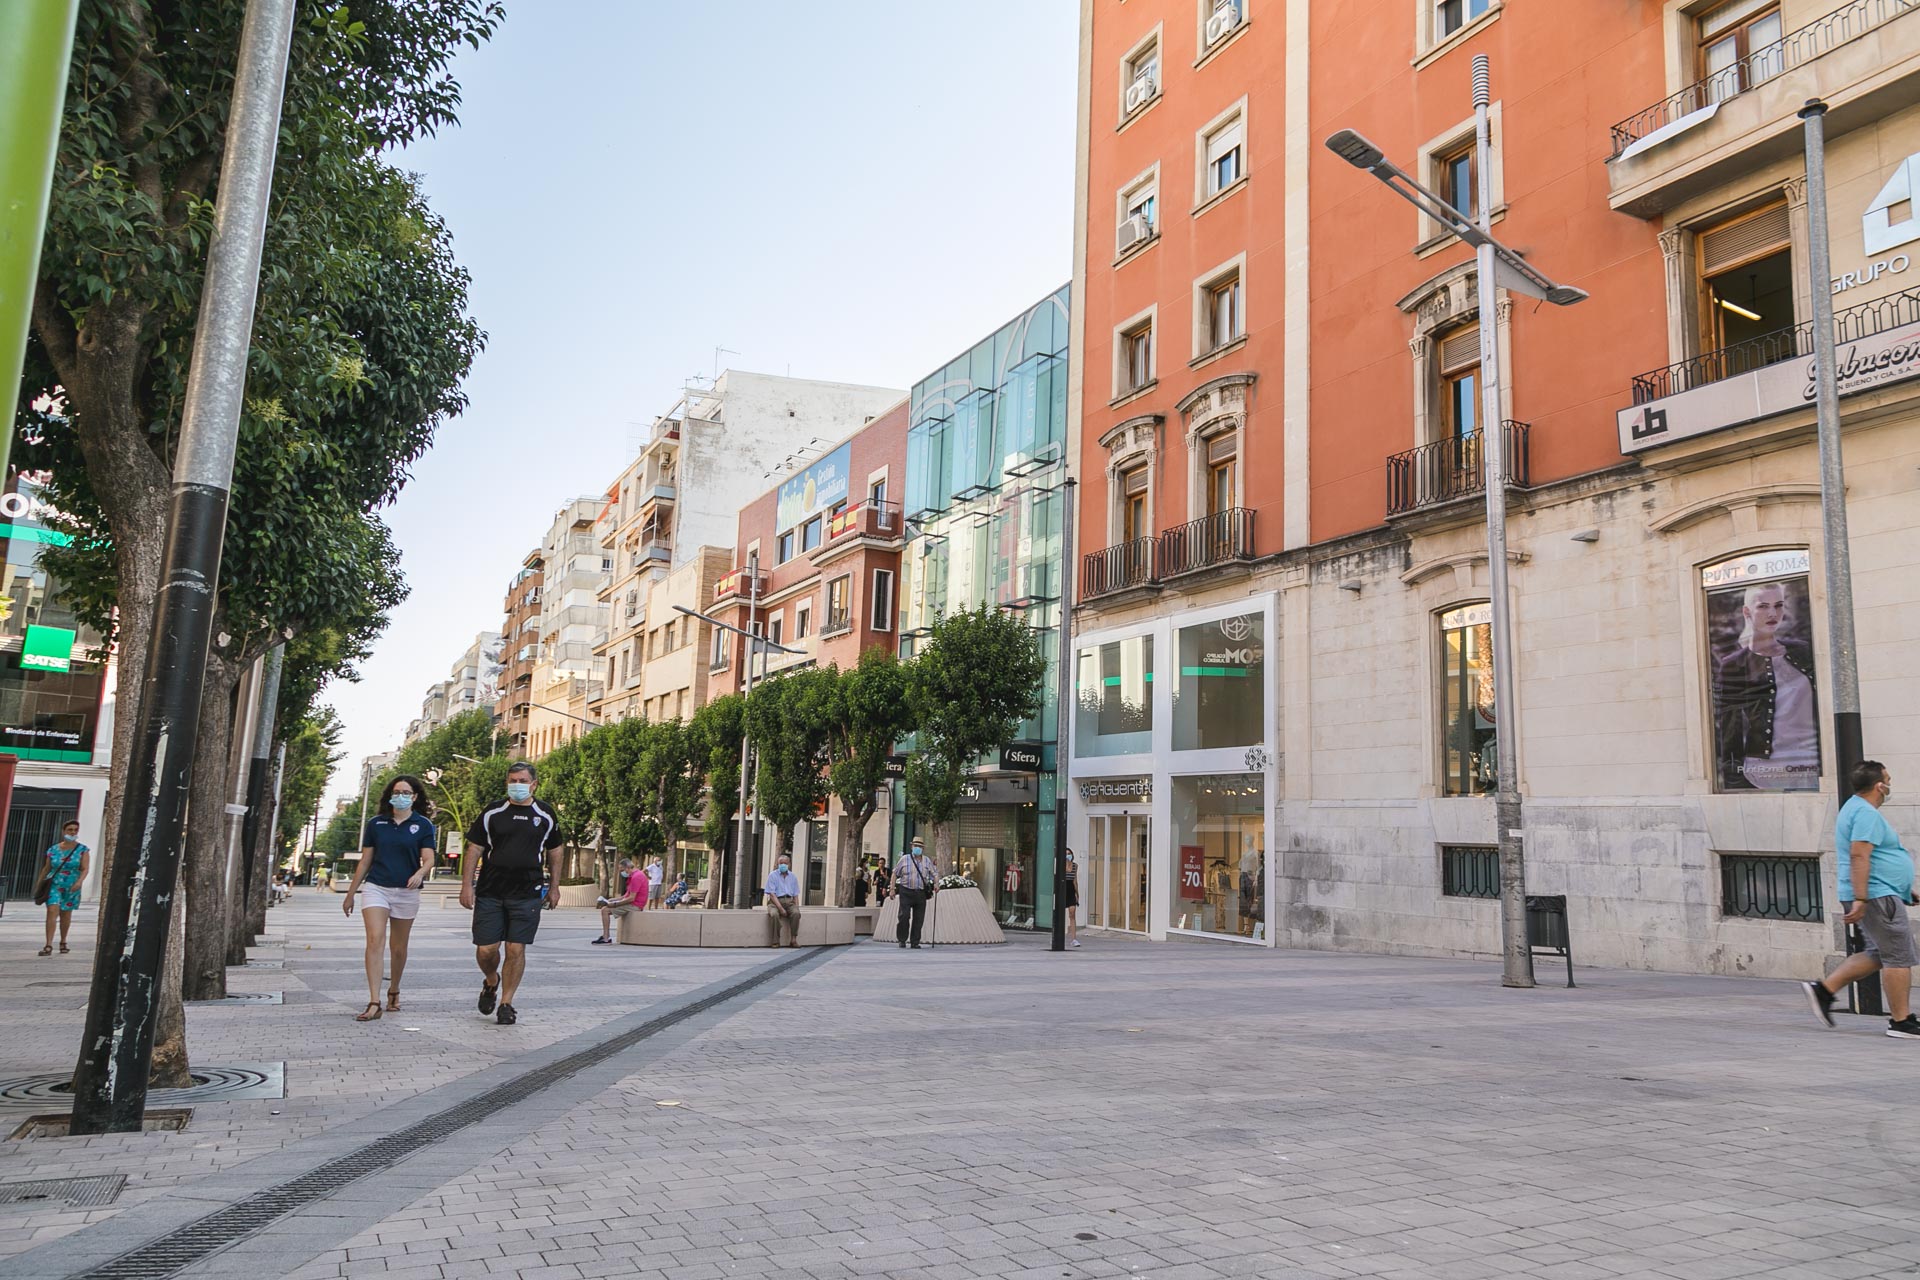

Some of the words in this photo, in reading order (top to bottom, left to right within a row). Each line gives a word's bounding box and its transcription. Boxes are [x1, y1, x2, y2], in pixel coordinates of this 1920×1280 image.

[1830, 254, 1910, 296] GRUPO
[1845, 376, 1872, 389] BUENO
[1898, 366, 1914, 375] S.A.
[1704, 566, 1741, 583] PUNT
[1765, 555, 1809, 574] ROMA
[23, 653, 70, 669] SATSE
[5, 727, 36, 736] Sindicato
